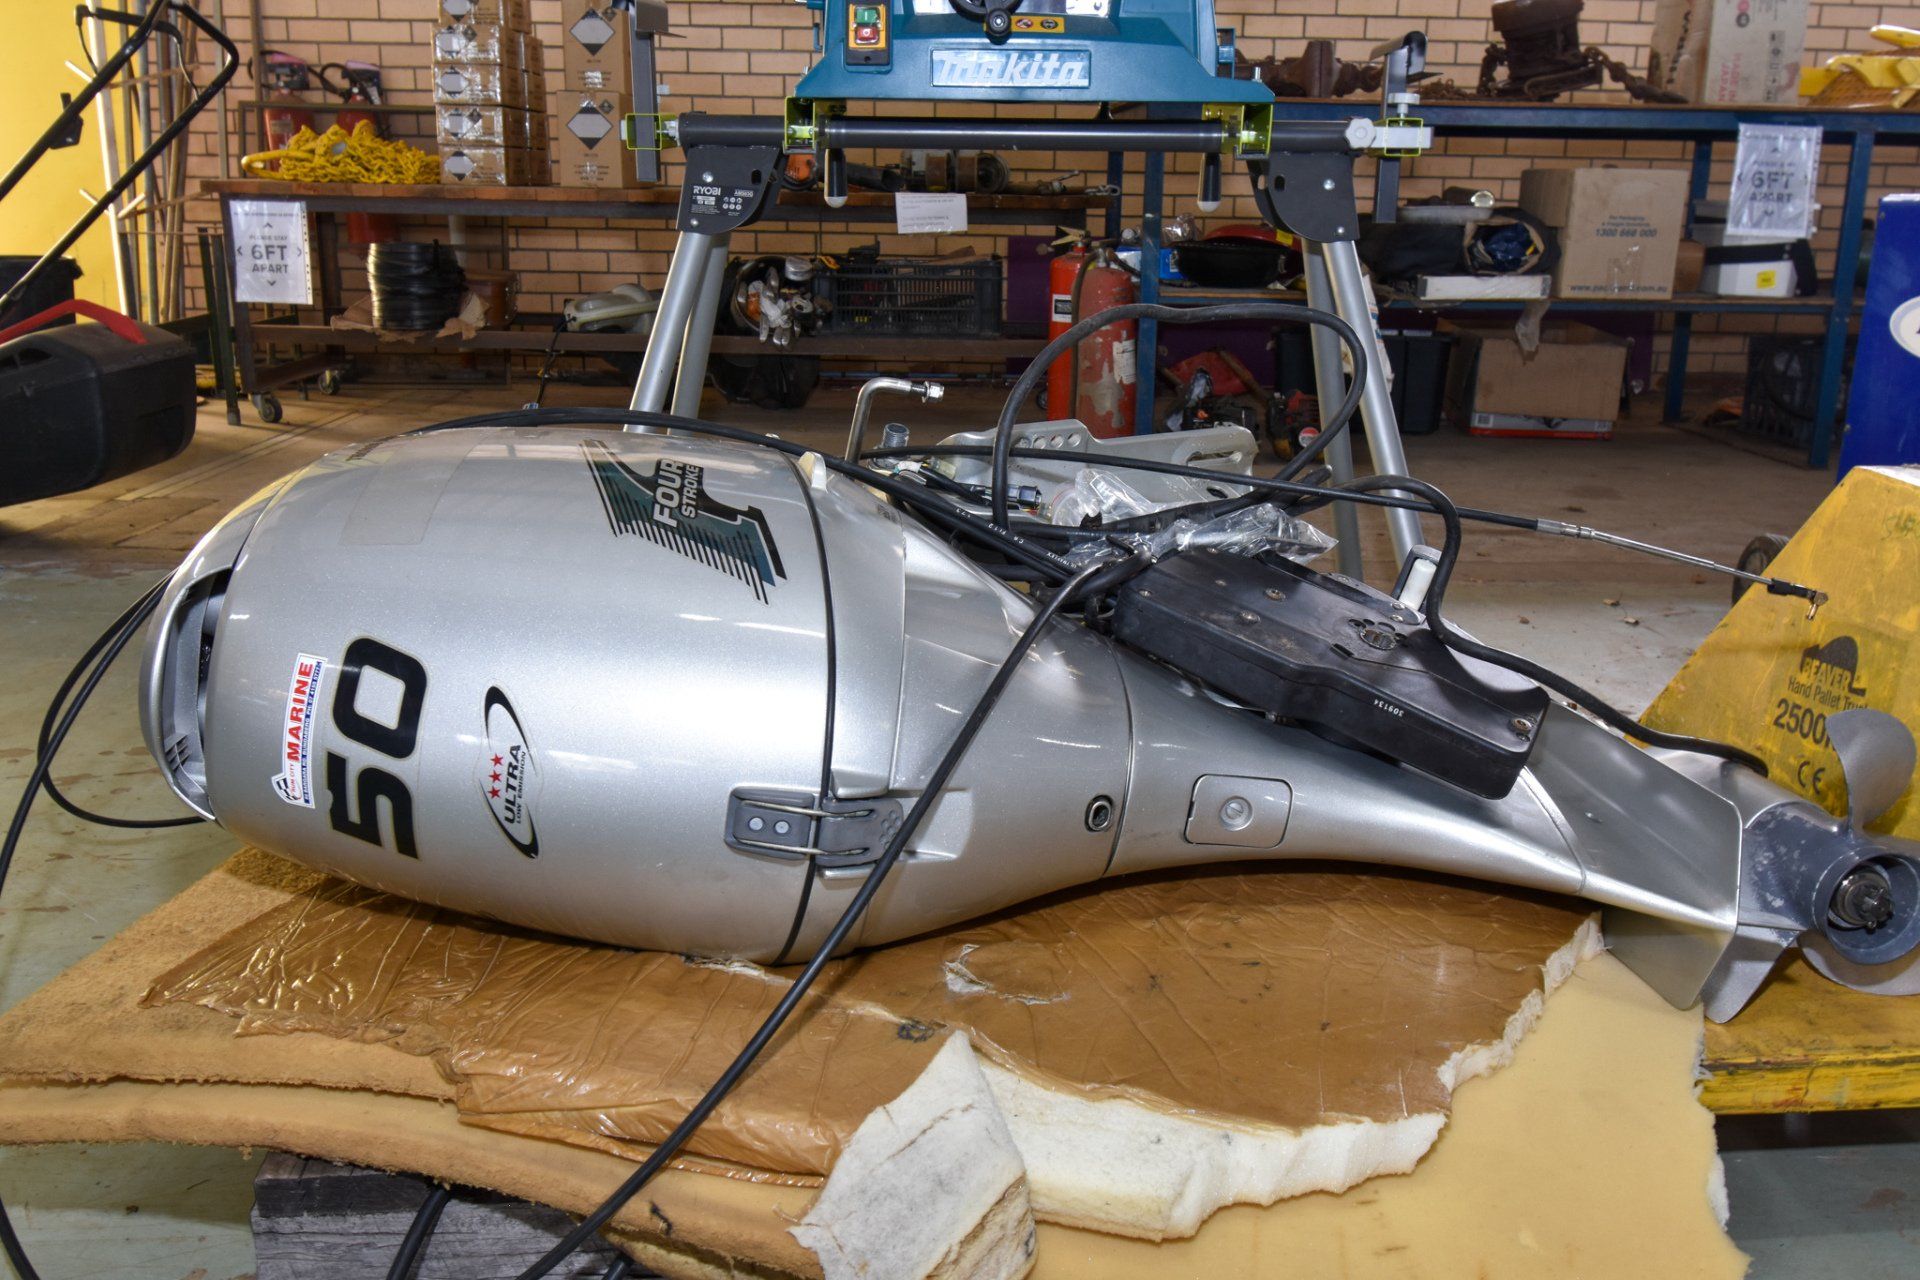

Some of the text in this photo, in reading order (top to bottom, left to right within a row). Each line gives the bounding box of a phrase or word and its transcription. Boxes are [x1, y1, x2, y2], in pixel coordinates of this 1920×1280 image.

[692, 185, 722, 196] RYOBI
[1751, 171, 1795, 189] 6FT
[251, 244, 288, 260] 6FT
[251, 263, 289, 274] APART
[653, 459, 685, 528] FOUR
[681, 464, 700, 519] STROKE
[287, 662, 313, 762] MARINE
[1373, 698, 1405, 717] 309134
[1787, 674, 1868, 711] Hand Pallet Tru
[326, 637, 428, 860] 50
[1773, 698, 1837, 751] 2500
[504, 744, 522, 824] ULTRA
[518, 751, 527, 799] EMISSION
